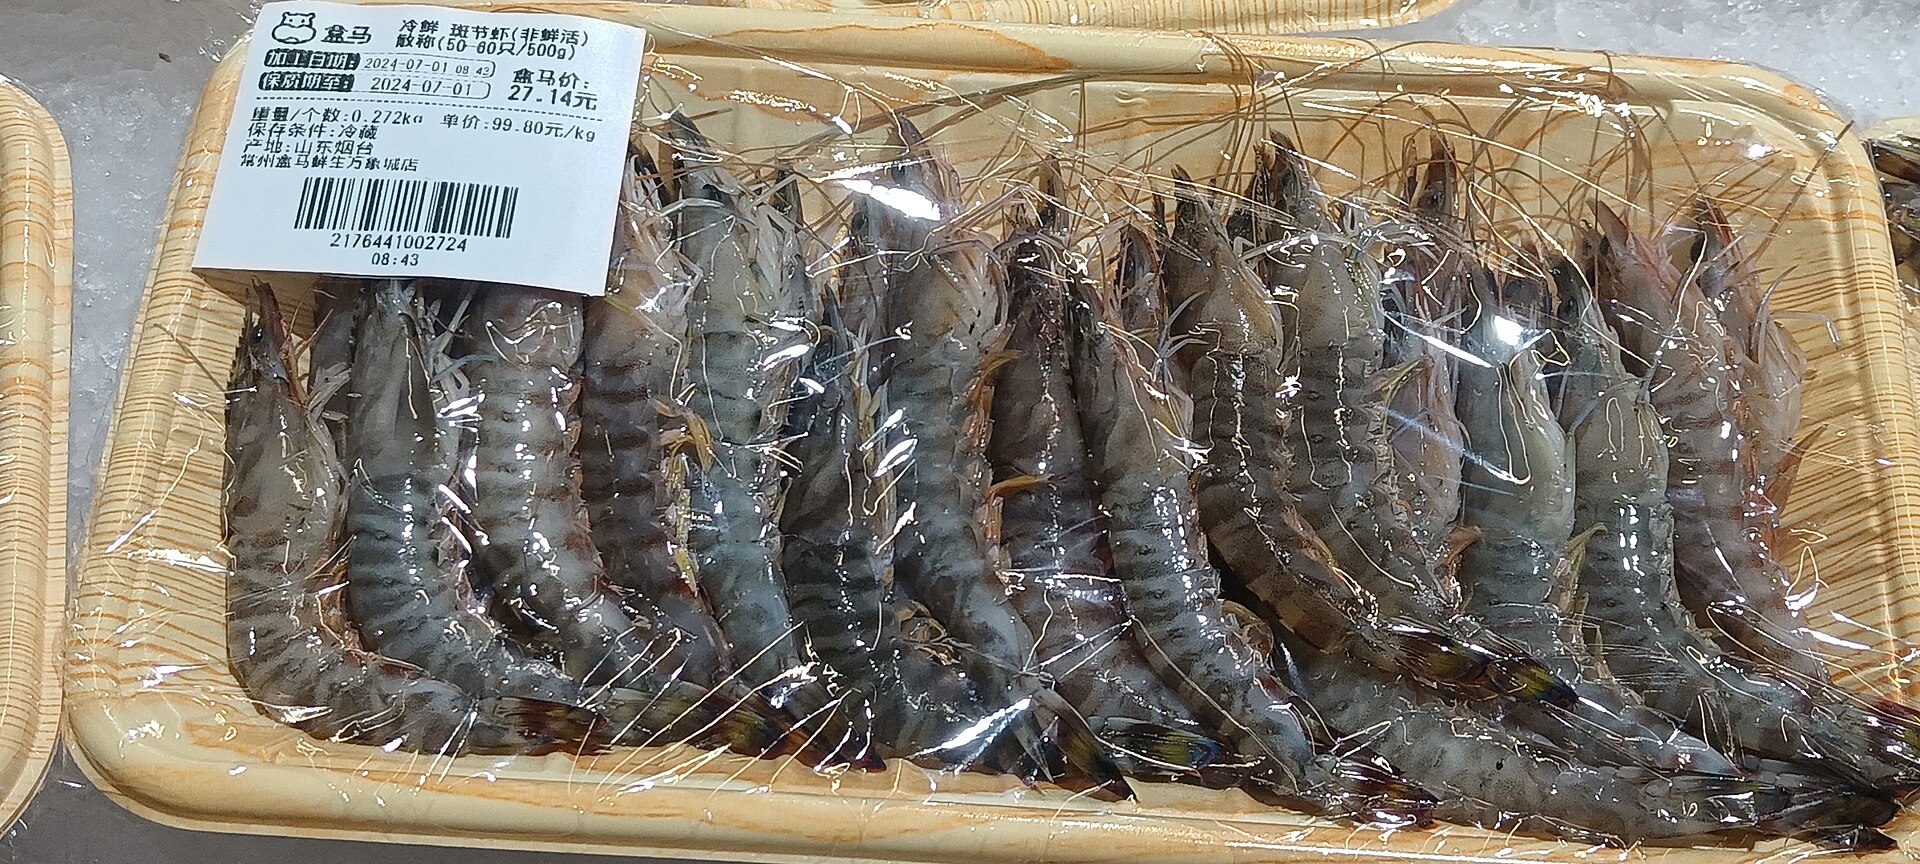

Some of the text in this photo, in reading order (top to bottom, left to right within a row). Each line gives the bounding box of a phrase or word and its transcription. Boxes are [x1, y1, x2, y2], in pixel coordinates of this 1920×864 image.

[321, 24, 371, 44] 盒马
[399, 19, 589, 47] 冷鲜 斑节虾(非鲜活)
[364, 58, 447, 73] 2024-07-01
[371, 77, 471, 94] 2024-07-01
[512, 68, 590, 89] 盒马价:
[507, 85, 598, 111] 27.14元
[248, 123, 378, 139] 保存条件:冷藏
[440, 114, 596, 142] 单价:99.80元/kg
[244, 138, 374, 155] 产地:山东烟台
[241, 154, 419, 171] 常州盒马鲜生万象城店
[331, 233, 468, 252] 2176441002724
[371, 252, 419, 267] 08:43
